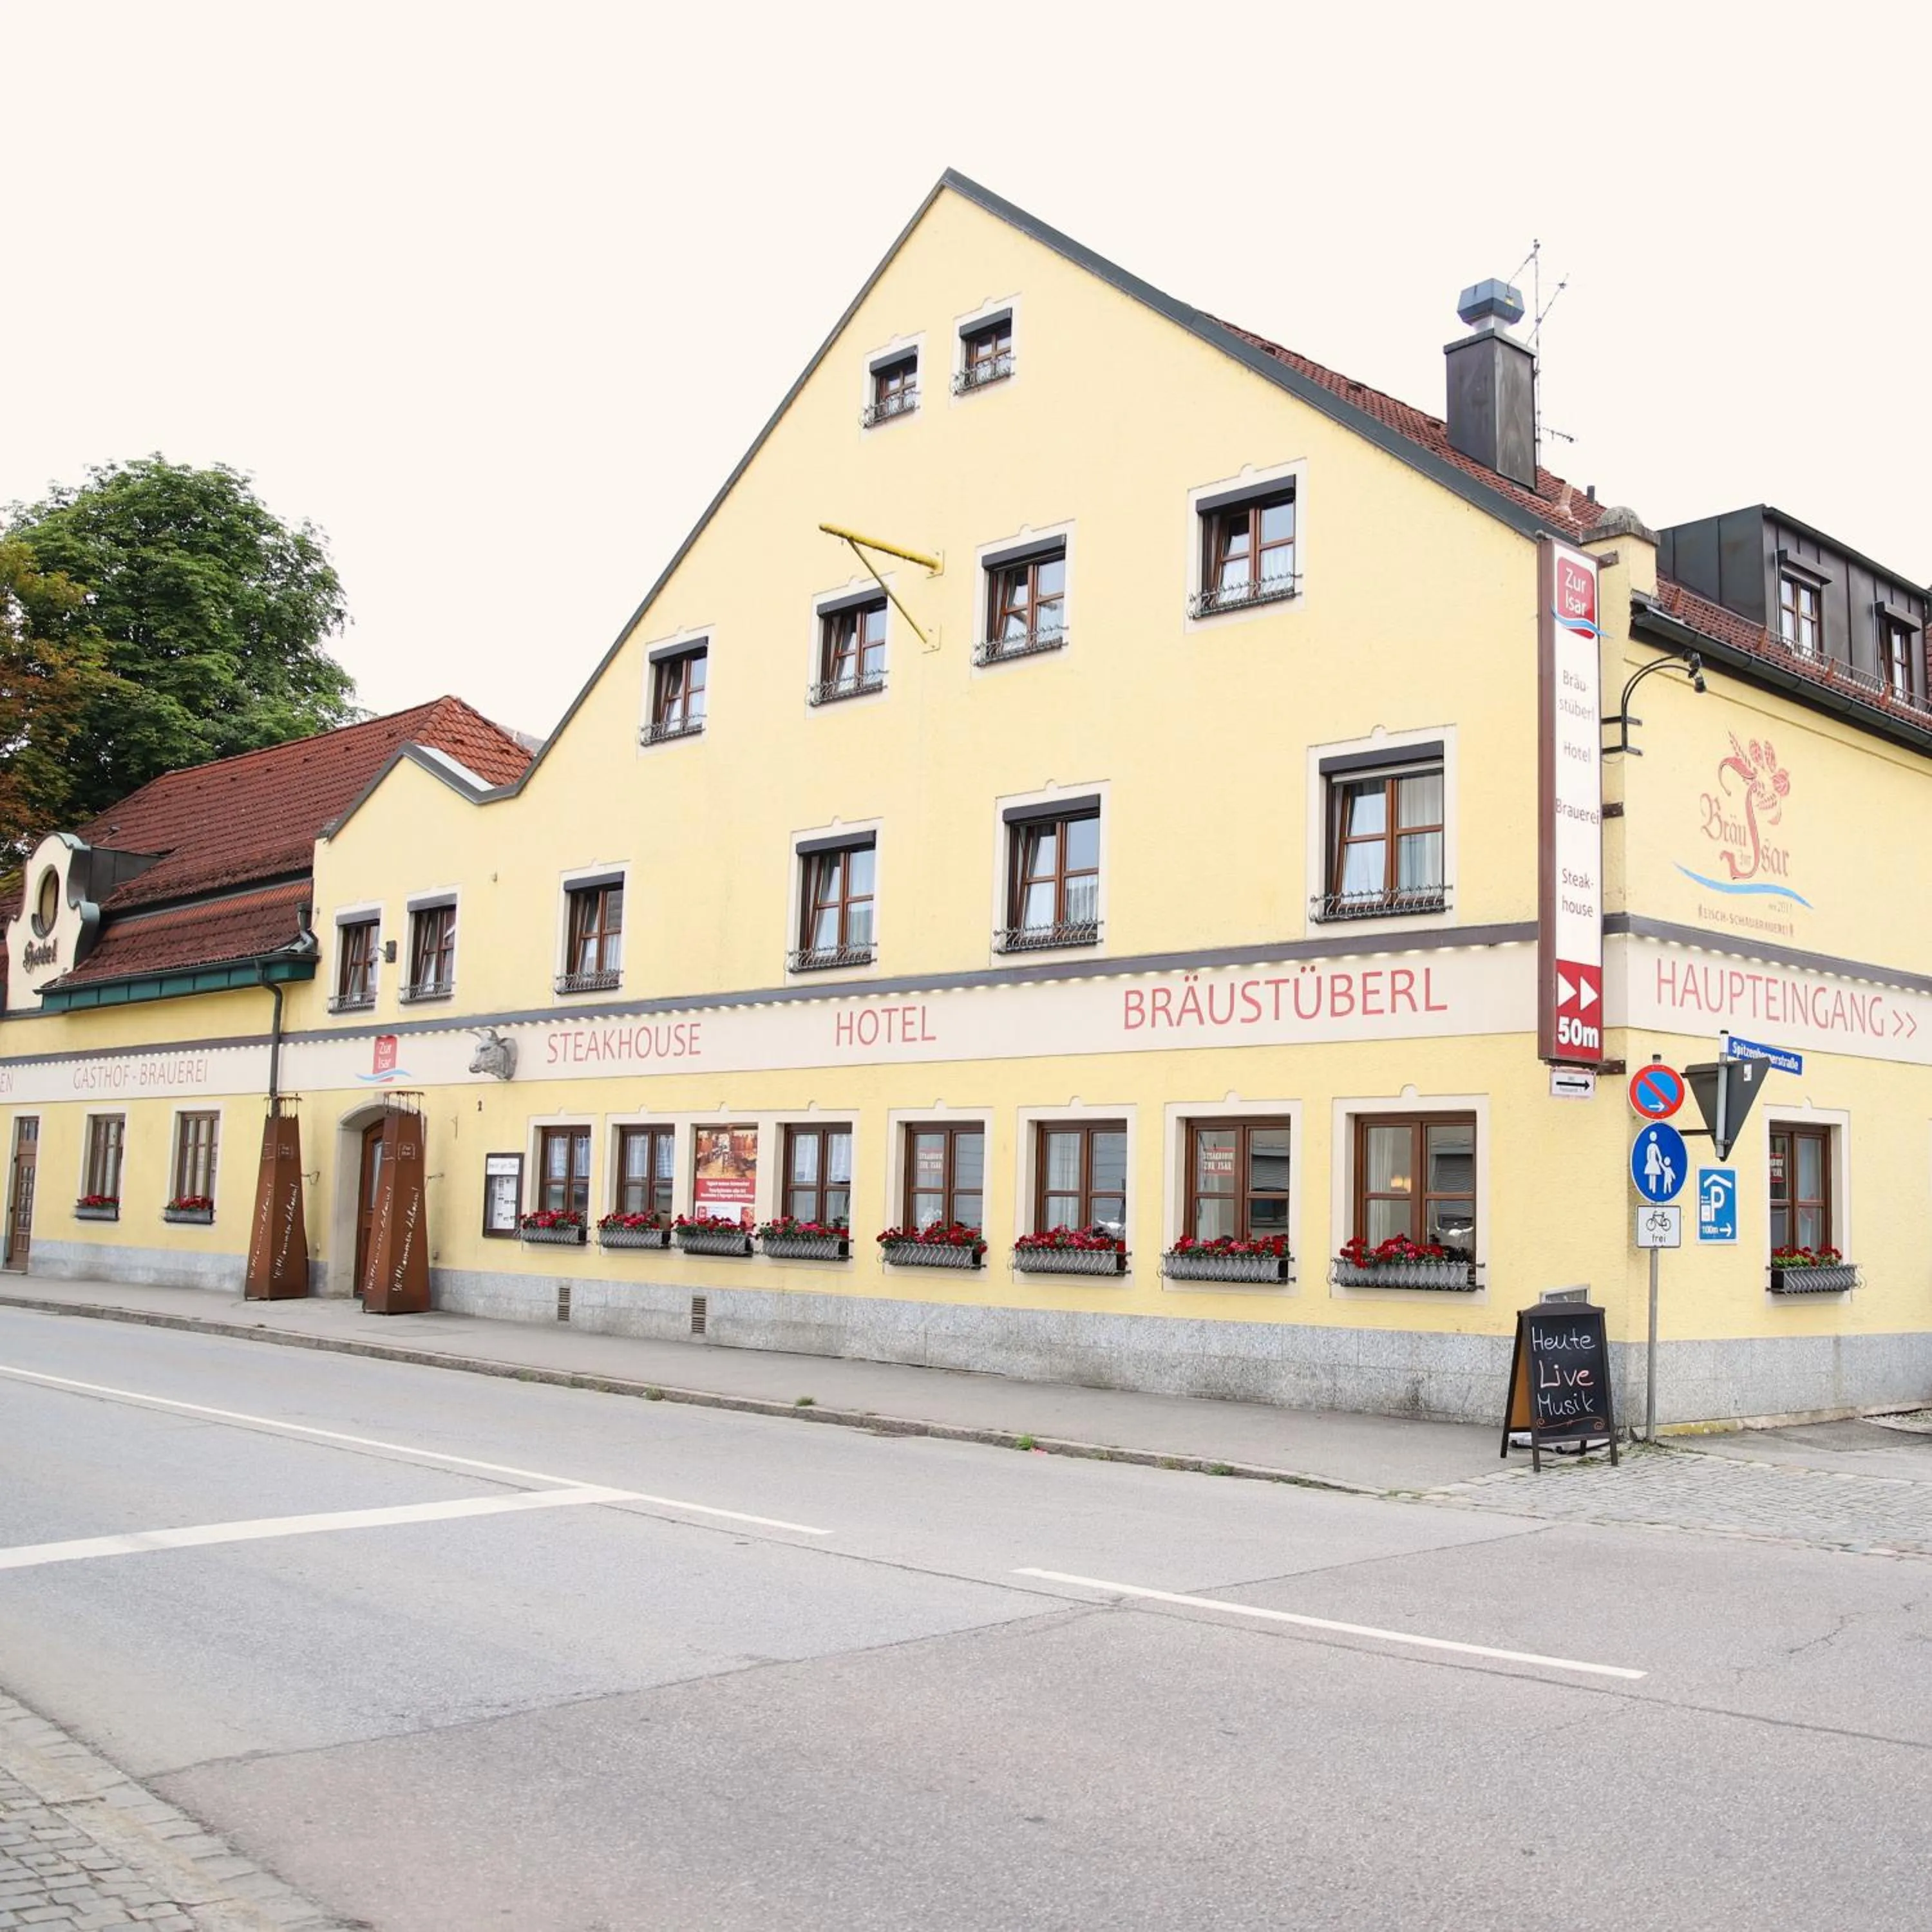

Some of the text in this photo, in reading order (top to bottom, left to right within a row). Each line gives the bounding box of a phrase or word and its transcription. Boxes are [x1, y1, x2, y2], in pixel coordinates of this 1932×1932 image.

[1566, 567, 1586, 593] Zur
[1566, 589, 1587, 616] Isar
[1563, 669, 1589, 692] Bräu-
[1558, 697, 1595, 722] stüberl
[1563, 741, 1591, 764] Hotel
[1555, 798, 1600, 826] Brauerei
[1700, 793, 1747, 847] Bräu
[1562, 867, 1594, 890] Steak-
[1562, 898, 1594, 918] house
[1124, 965, 1449, 1030] BRÄUSTÜBERL
[1657, 958, 1884, 1037] HAUPTEINGANG
[835, 1005, 937, 1047] HOTEL
[1557, 1016, 1600, 1048] 50m
[378, 1042, 392, 1055] Zur
[547, 1023, 703, 1065] STEAKHOUSE
[73, 1064, 130, 1090] GASTHOF
[139, 1059, 208, 1085] BRAUEREI
[378, 1057, 392, 1069] Isar
[1710, 1186, 1725, 1222] P
[1652, 1233, 1667, 1243] frei
[1531, 1326, 1596, 1352] Heute
[1539, 1359, 1594, 1389] Live
[1537, 1391, 1595, 1417] Musik
